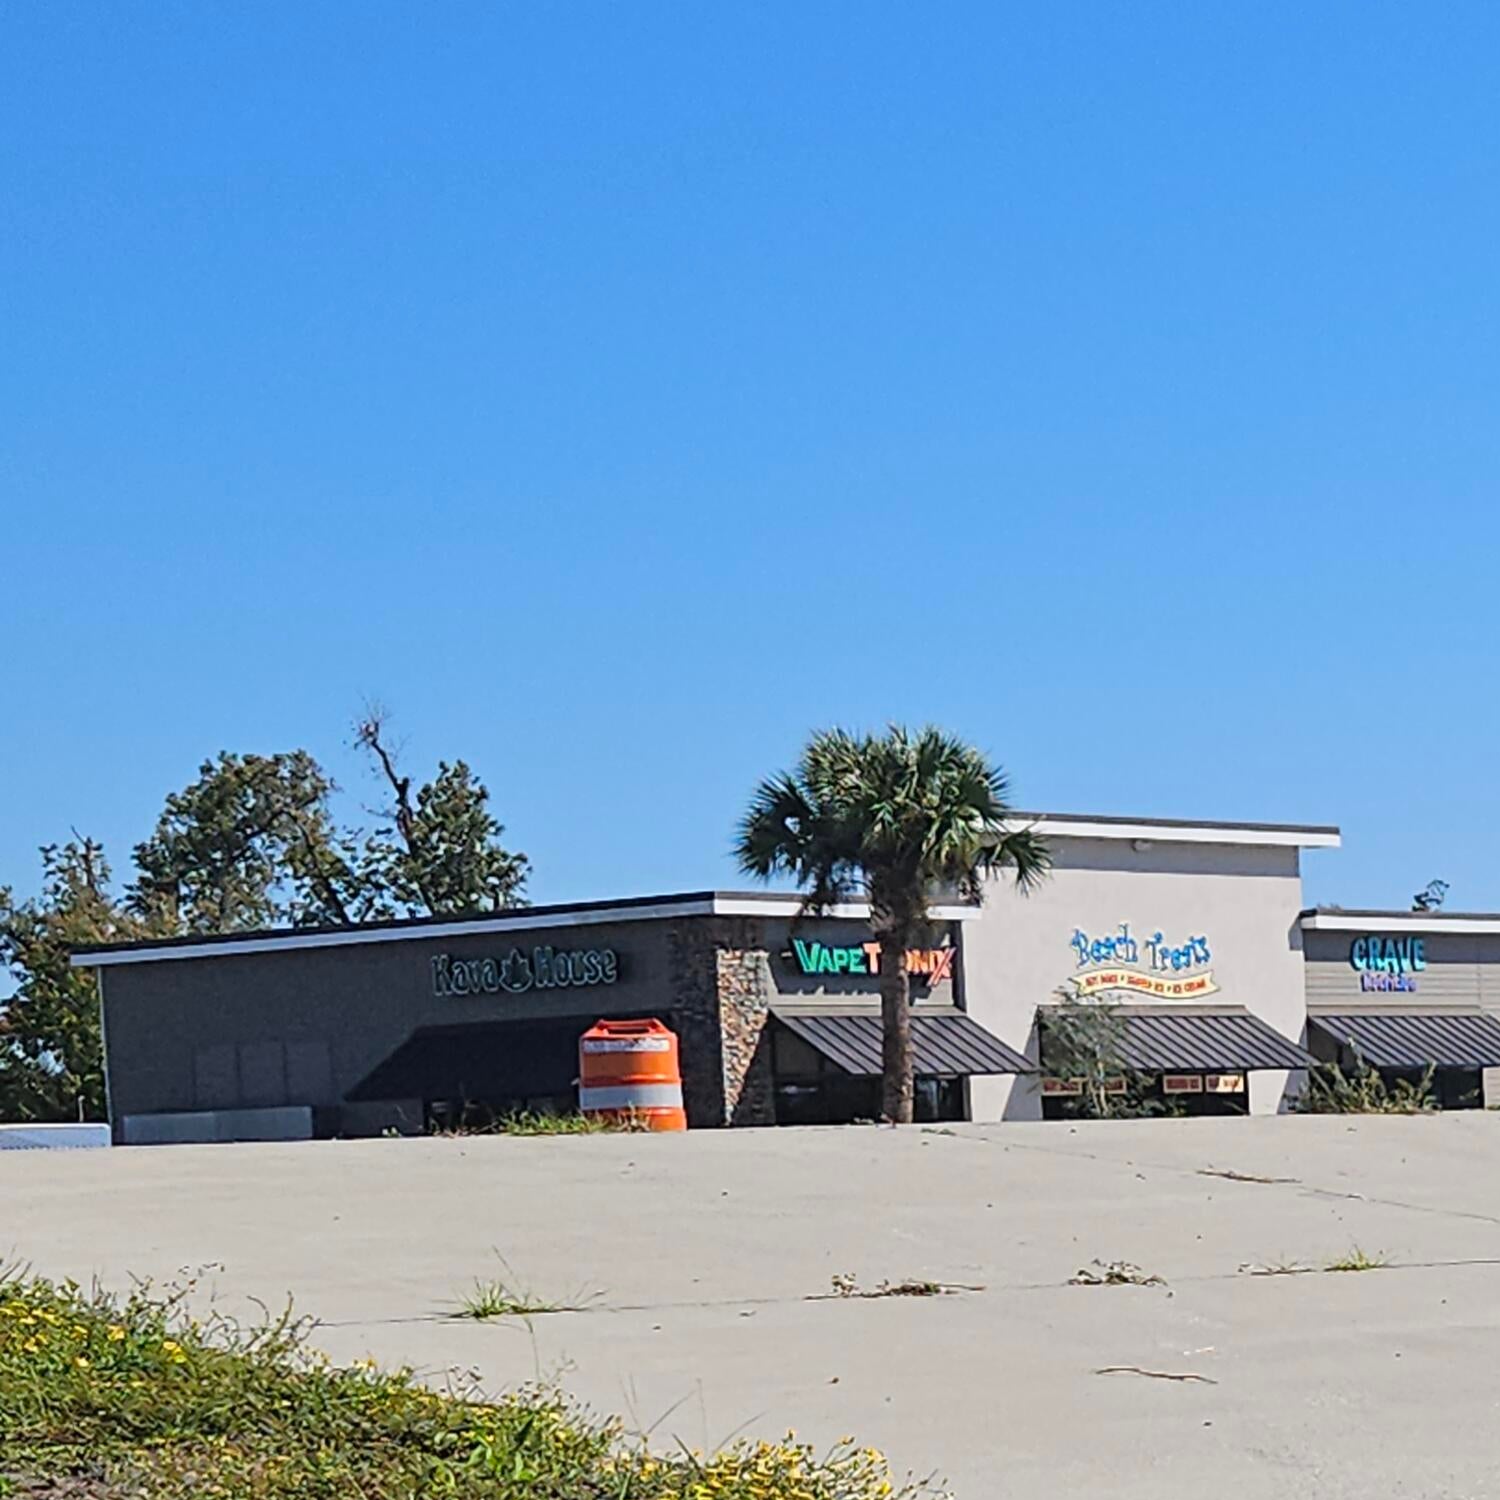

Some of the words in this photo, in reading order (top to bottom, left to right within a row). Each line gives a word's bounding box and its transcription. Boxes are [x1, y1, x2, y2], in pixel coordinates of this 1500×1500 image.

[431, 953, 498, 996] Kava
[534, 946, 617, 988] House
[1350, 936, 1426, 974] CRAVE
